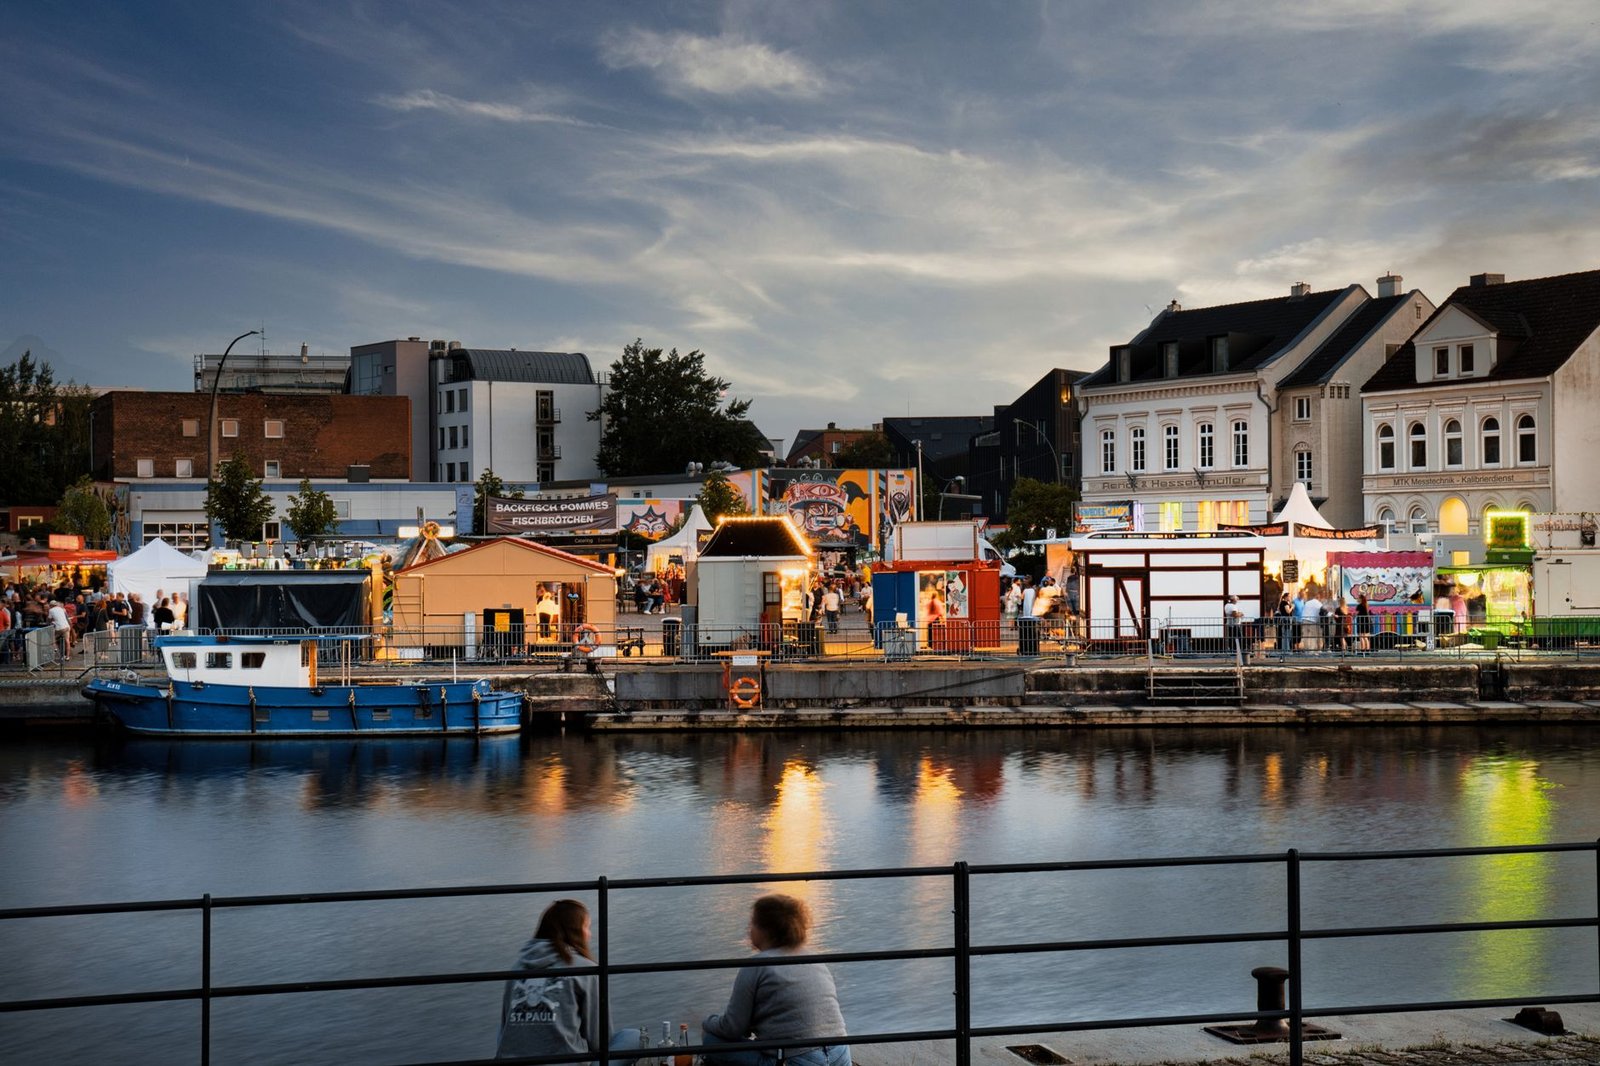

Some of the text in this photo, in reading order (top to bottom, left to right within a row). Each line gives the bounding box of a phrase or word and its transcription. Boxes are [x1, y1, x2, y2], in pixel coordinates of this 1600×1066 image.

[1393, 478, 1409, 487] MTK
[1411, 476, 1454, 486] Messtechnik
[1461, 474, 1514, 483] Kalibrierdienst
[496, 501, 609, 512] BACKFISCH POMMES
[512, 515, 594, 525] FISCHBRÖTCHEN
[510, 1012, 557, 1021] ST. PAULI
